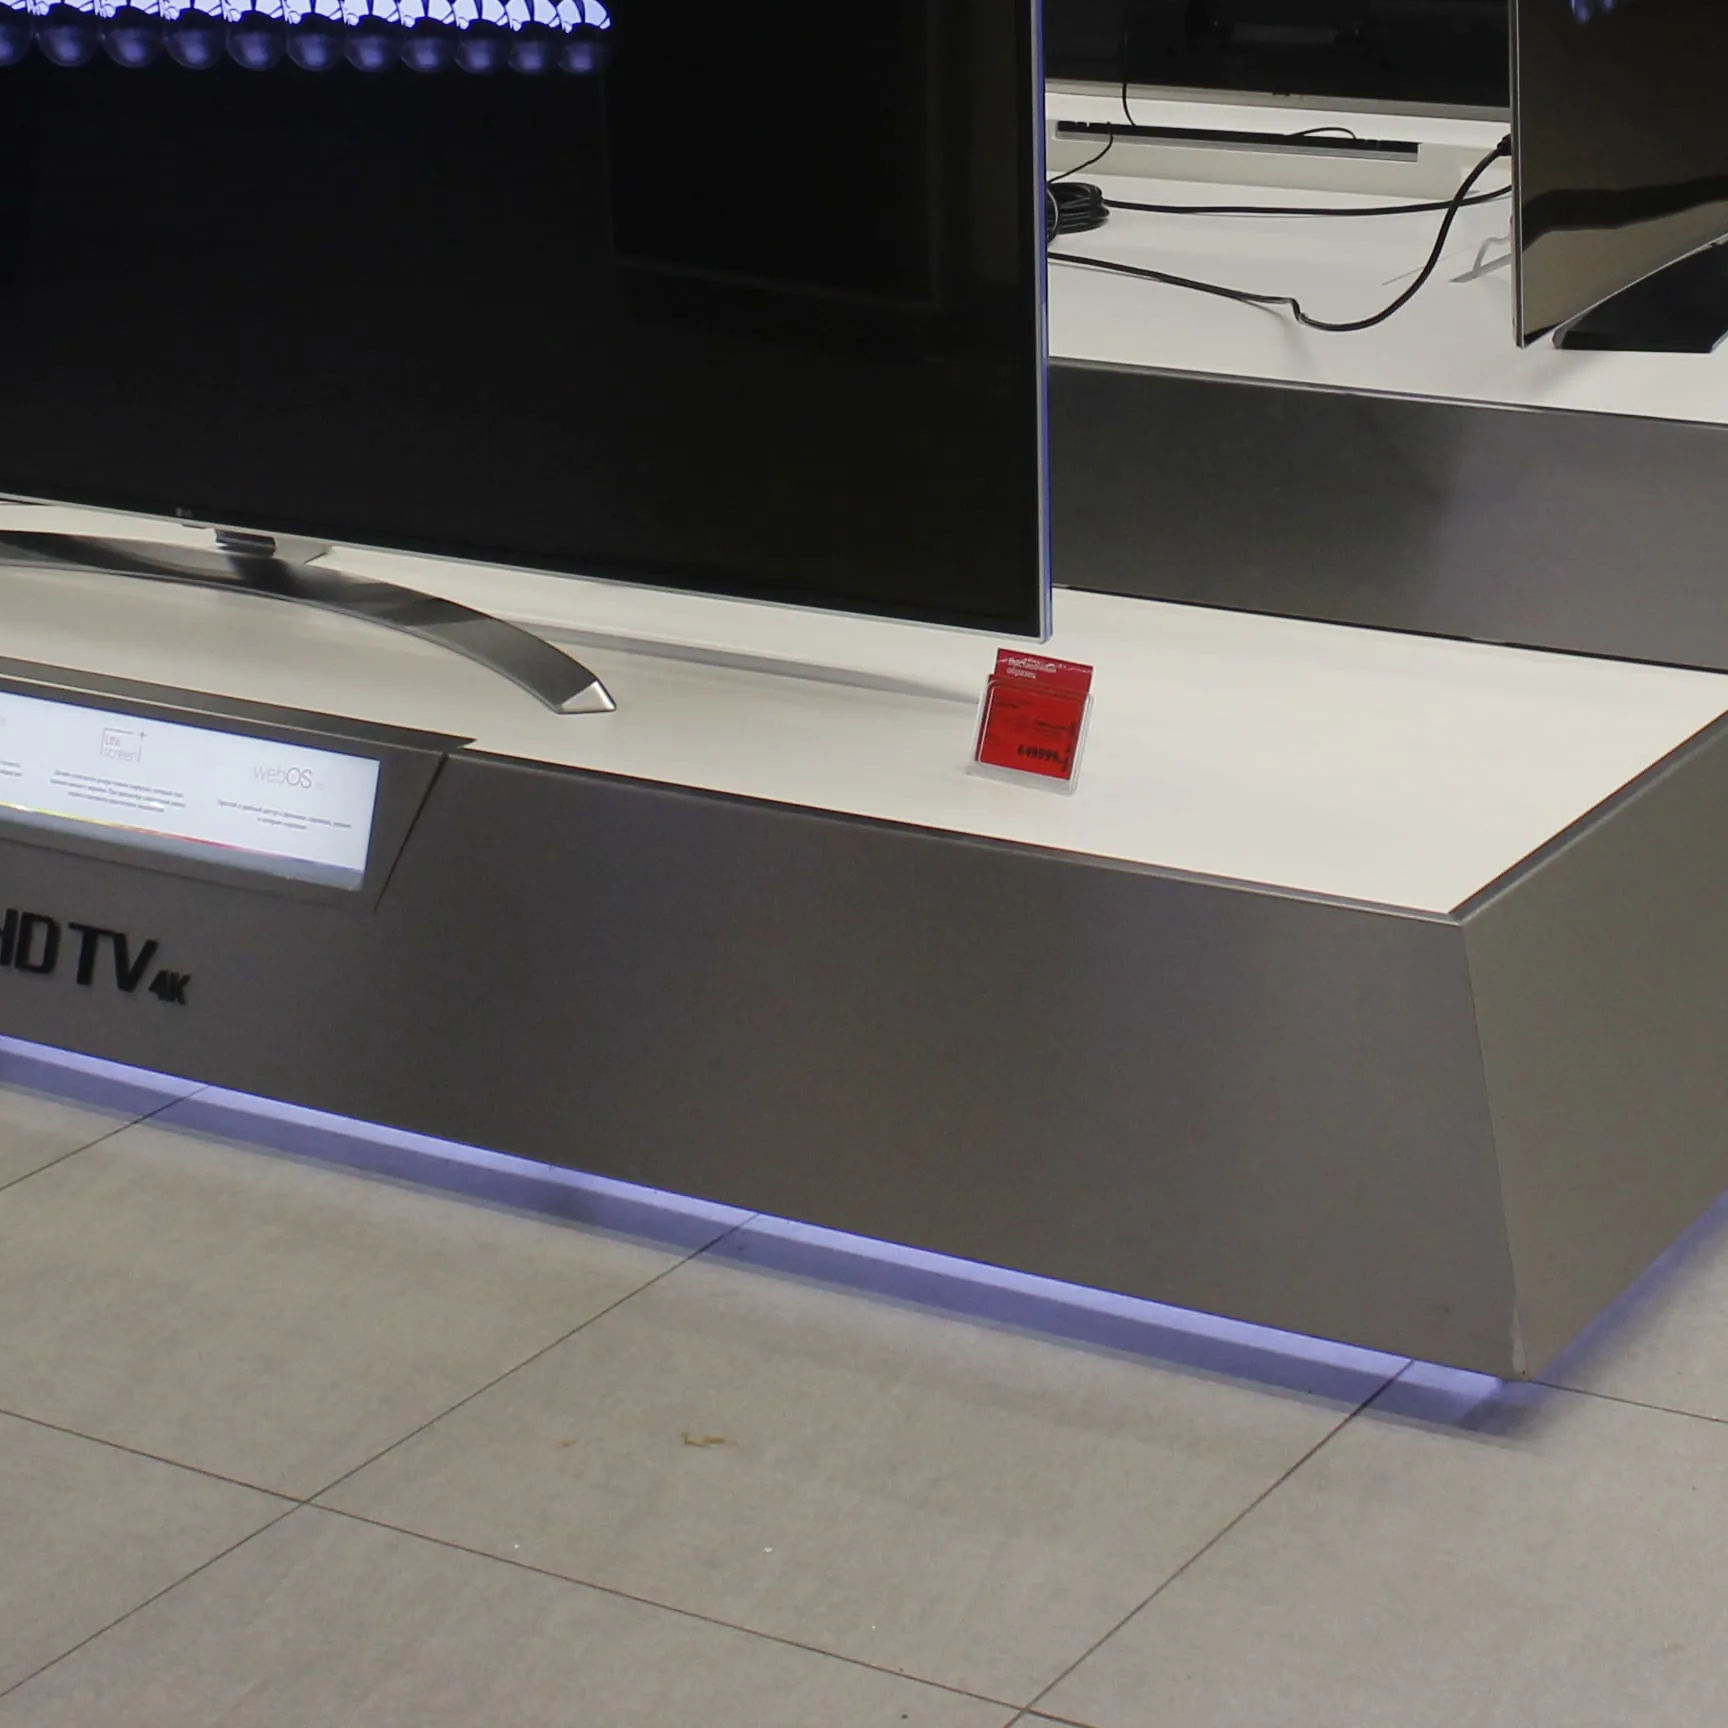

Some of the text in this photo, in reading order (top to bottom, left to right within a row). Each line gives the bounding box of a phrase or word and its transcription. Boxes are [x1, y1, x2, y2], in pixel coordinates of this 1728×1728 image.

[253, 765, 313, 789] webOS
[68, 922, 159, 993] TV
[148, 969, 191, 1005] 4K
